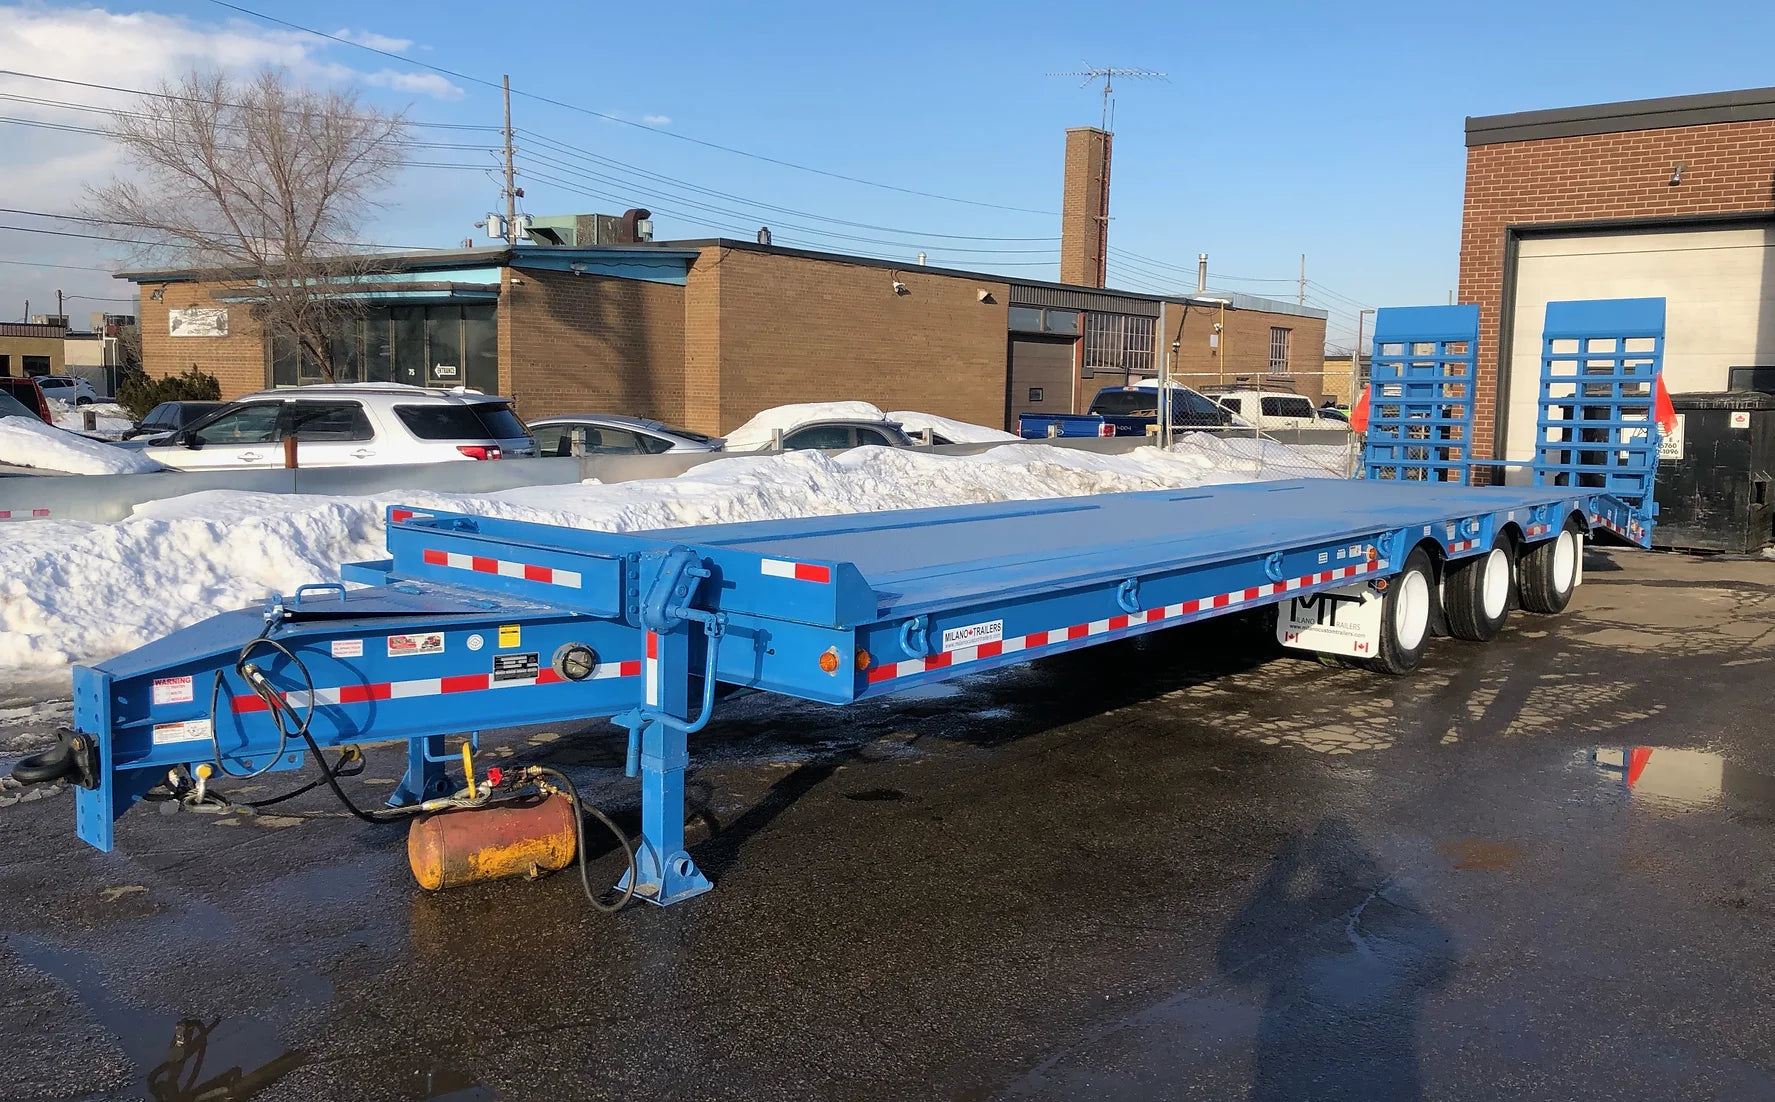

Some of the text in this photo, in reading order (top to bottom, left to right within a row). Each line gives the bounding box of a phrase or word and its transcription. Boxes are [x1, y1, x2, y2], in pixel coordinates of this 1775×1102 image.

[945, 623, 1001, 642] MILANO TRAILERS
[155, 677, 191, 686] WARNING
